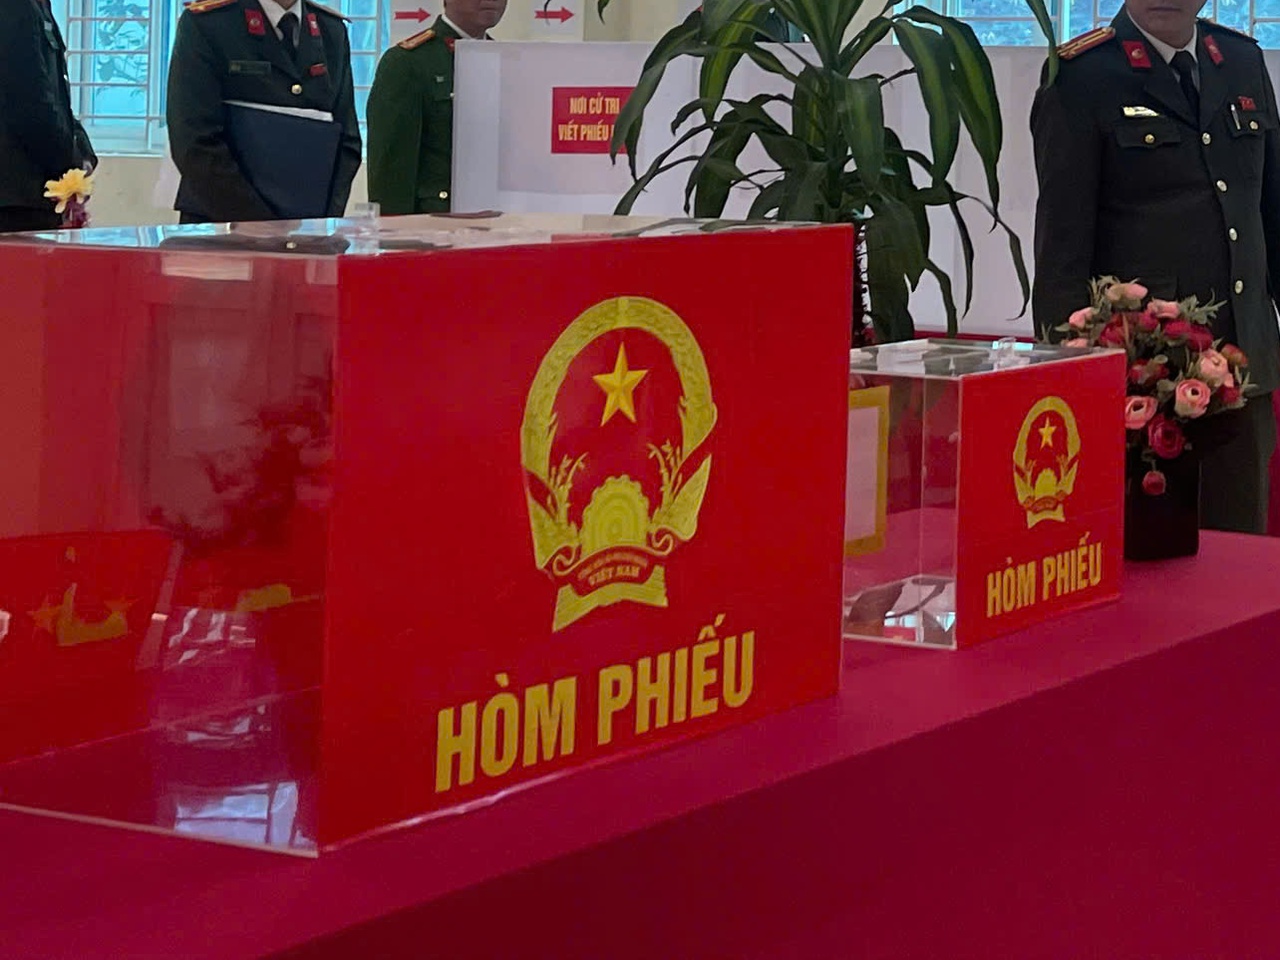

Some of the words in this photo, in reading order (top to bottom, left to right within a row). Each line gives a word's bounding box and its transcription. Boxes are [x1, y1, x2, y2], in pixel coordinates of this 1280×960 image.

[558, 119, 579, 141] VIẾT
[580, 119, 609, 141] PHIẾU
[570, 96, 587, 114] NƠI
[605, 97, 620, 114] TRI
[986, 556, 1037, 618] HÒM
[1042, 531, 1102, 602] PHIẾU
[435, 673, 577, 793] HÒM
[597, 613, 755, 746] PHIẾU
